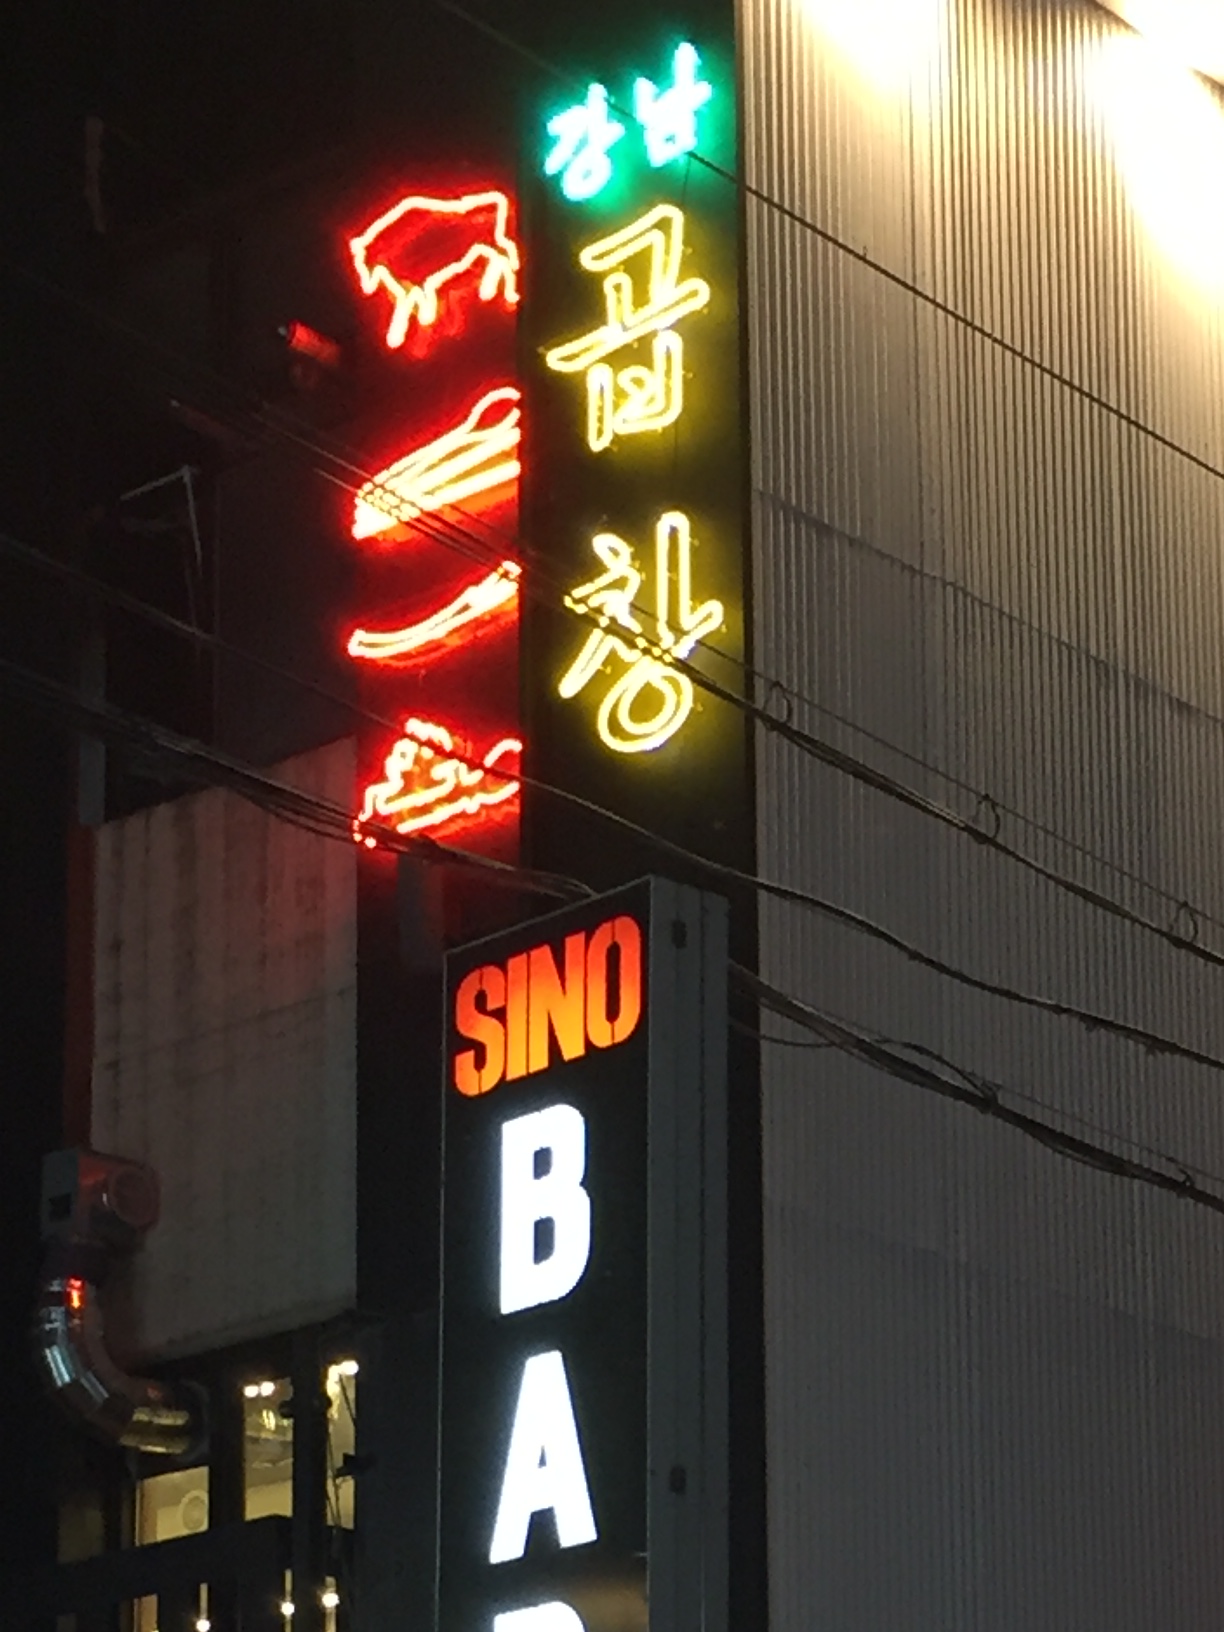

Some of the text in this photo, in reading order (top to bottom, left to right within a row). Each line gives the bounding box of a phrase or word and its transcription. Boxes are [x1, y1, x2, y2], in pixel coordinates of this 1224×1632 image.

[545, 42, 711, 200] 강남
[547, 204, 723, 752] 곱창
[454, 914, 642, 1097] SINO
